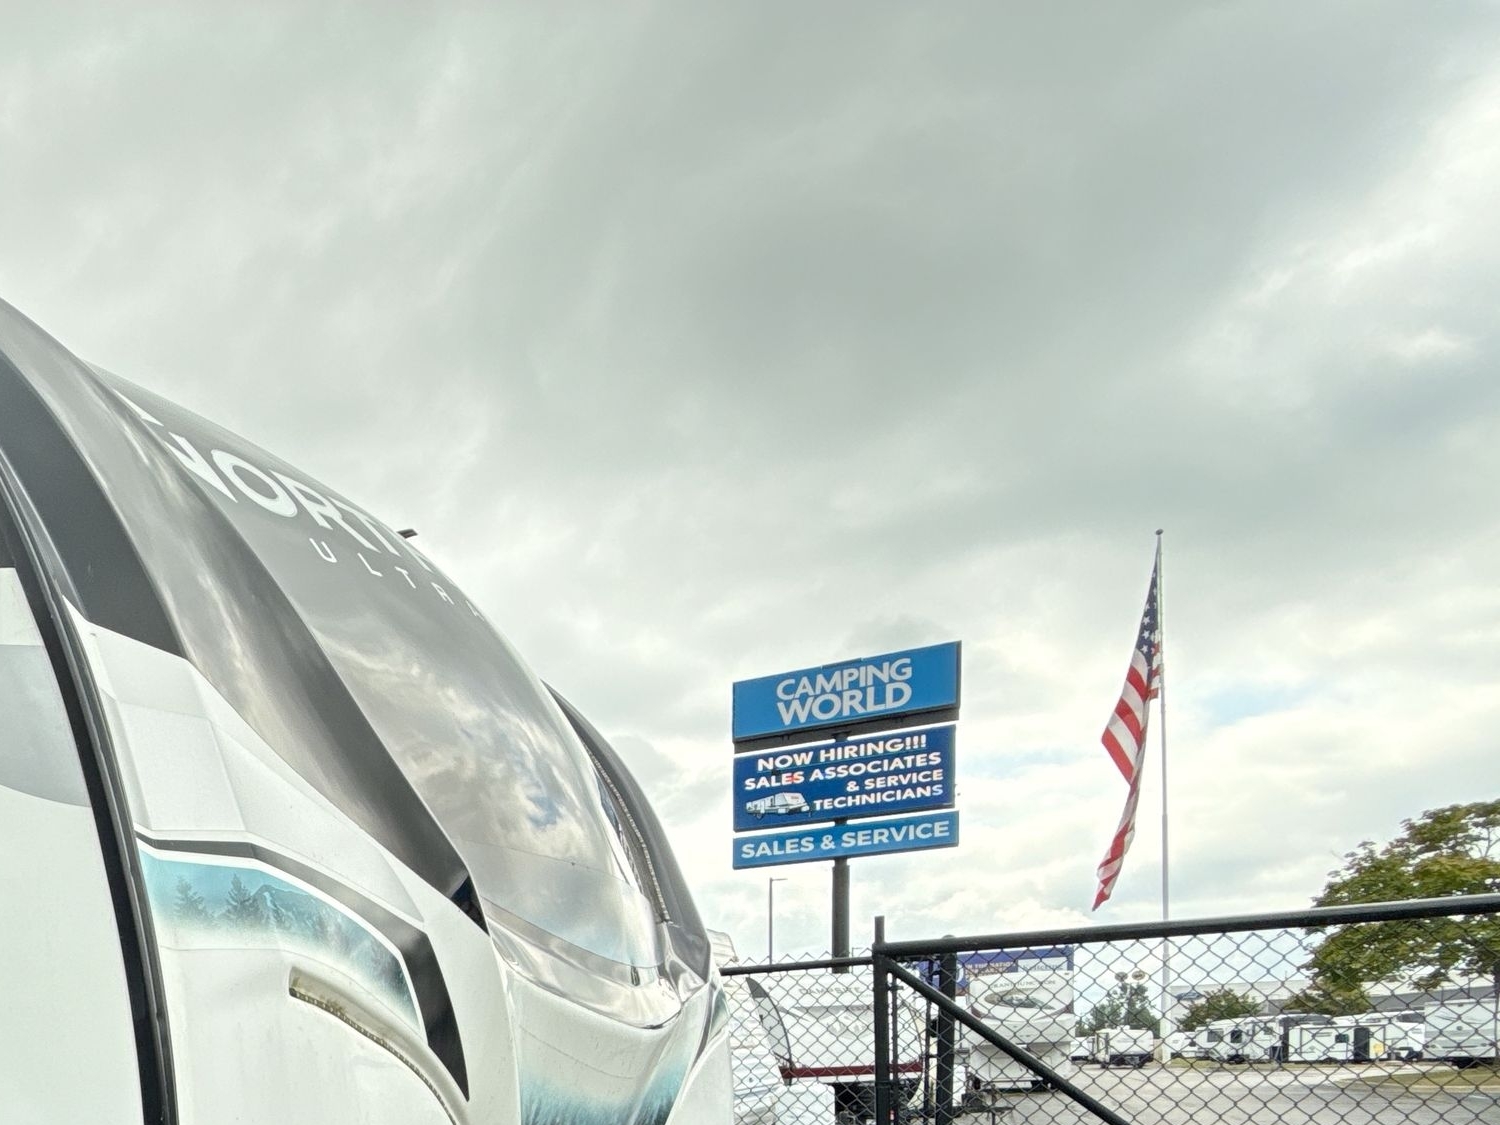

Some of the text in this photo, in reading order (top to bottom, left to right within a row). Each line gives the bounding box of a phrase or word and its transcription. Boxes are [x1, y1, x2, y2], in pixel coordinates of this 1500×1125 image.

[776, 657, 913, 700] CAMPING
[776, 682, 913, 726] WORLD
[744, 751, 942, 791] SALES ASSOCIATES
[757, 734, 927, 773] NOW HIRING!!!
[813, 784, 943, 811] TECHNICIANS
[846, 769, 943, 793] & SERVICE
[740, 820, 950, 859] SALES & SERVICE
